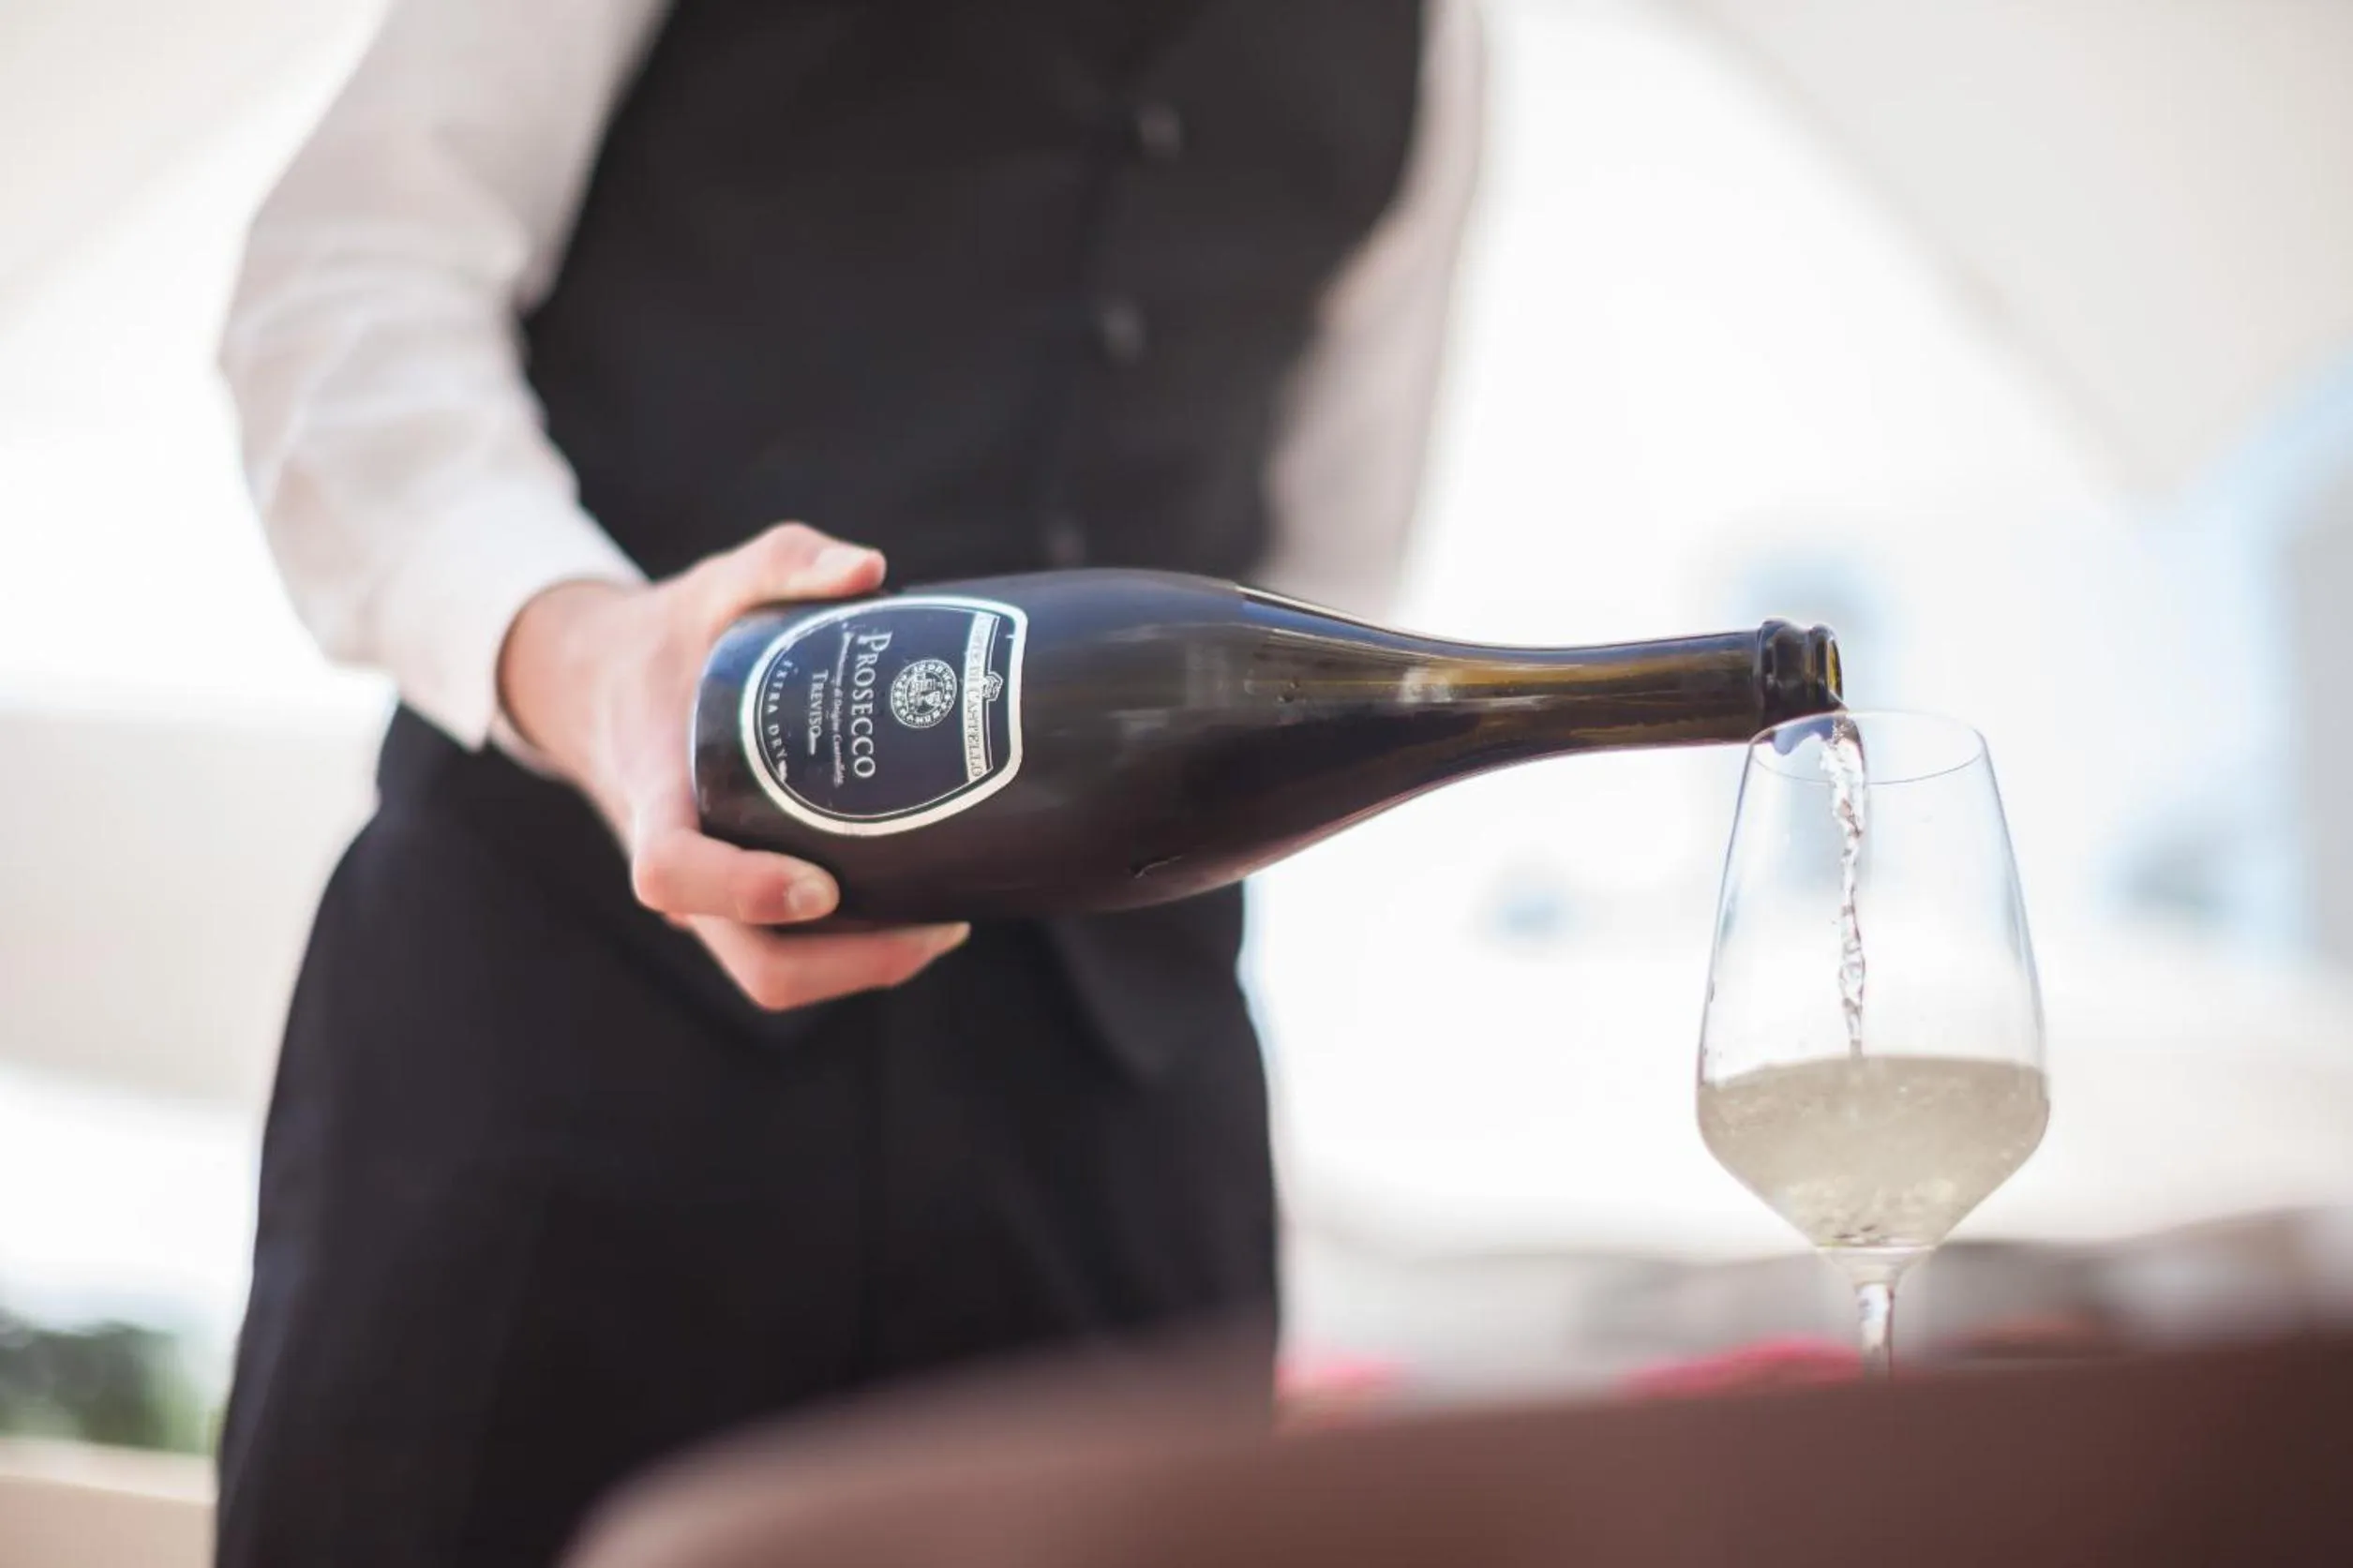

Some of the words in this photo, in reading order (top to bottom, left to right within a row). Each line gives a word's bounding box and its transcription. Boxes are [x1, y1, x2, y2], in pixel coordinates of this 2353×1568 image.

[766, 660, 793, 714] EXTRA
[808, 669, 829, 739] TREVISO
[852, 631, 892, 778] PROSECCO
[767, 724, 787, 761] DRY
